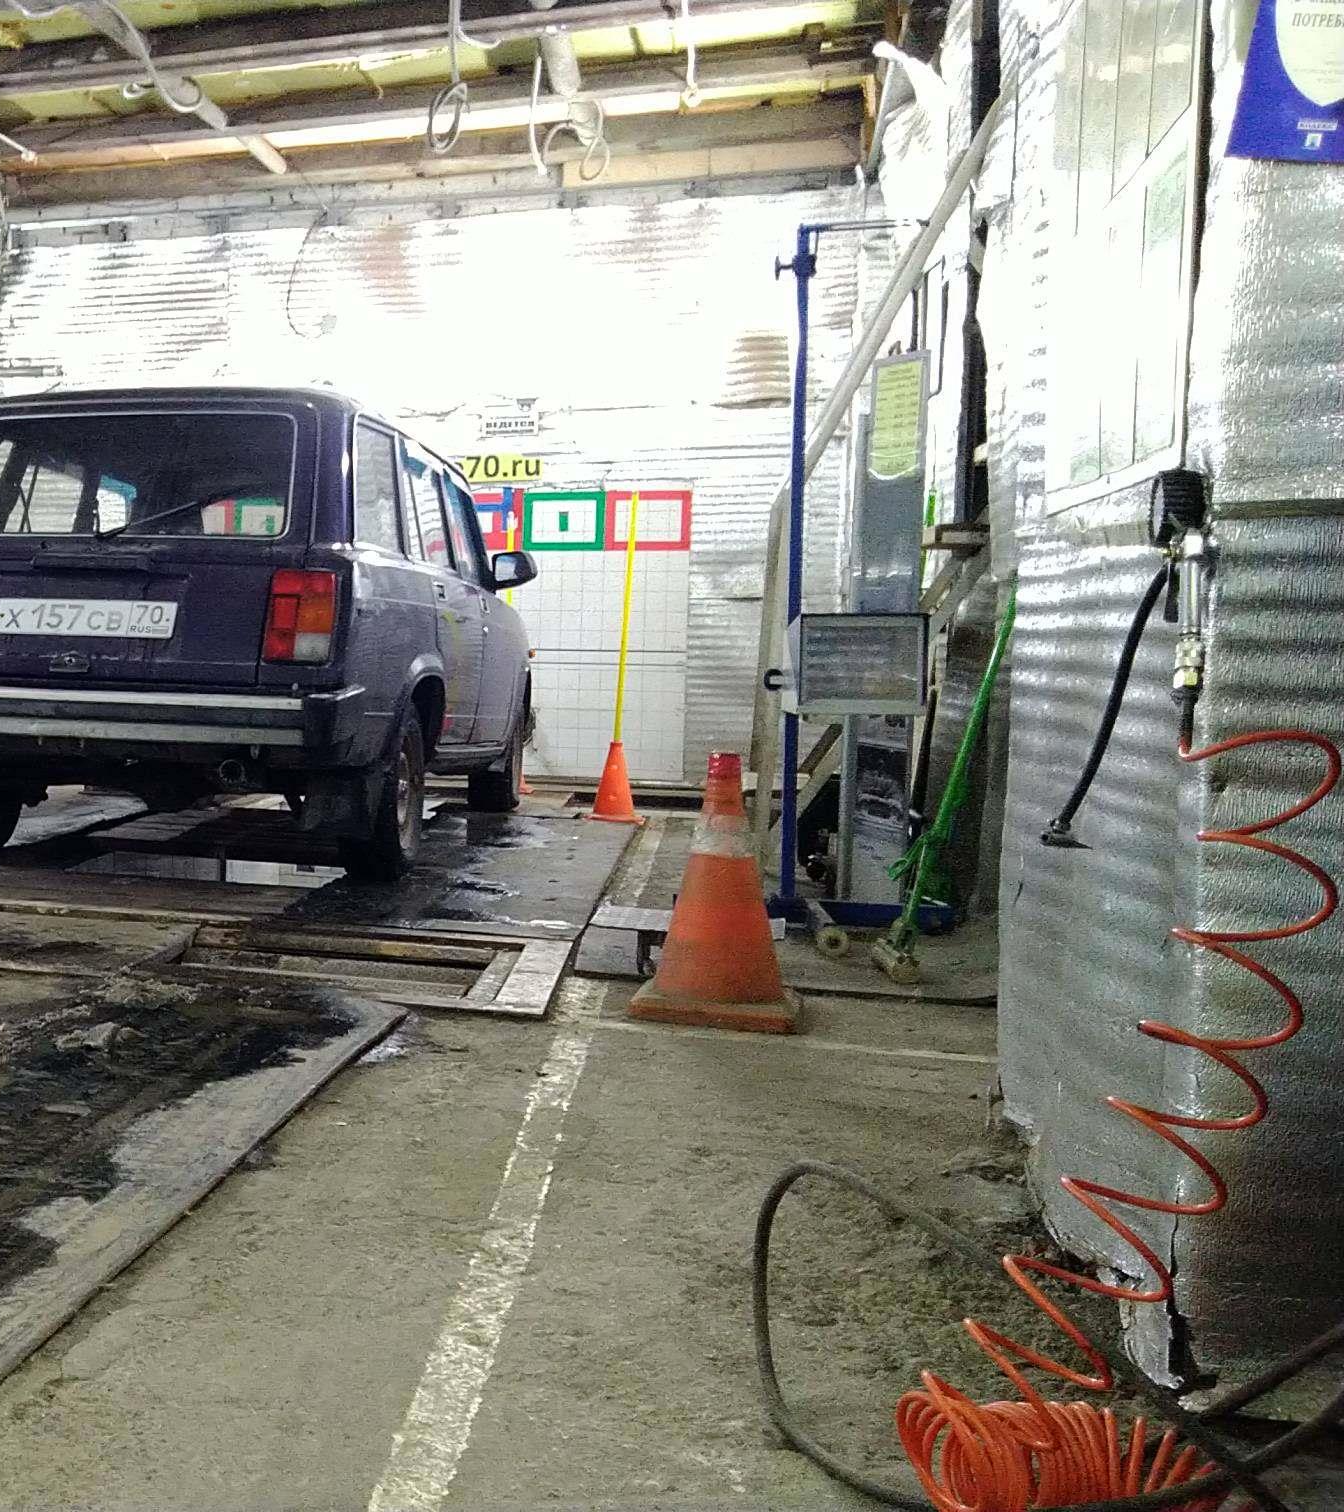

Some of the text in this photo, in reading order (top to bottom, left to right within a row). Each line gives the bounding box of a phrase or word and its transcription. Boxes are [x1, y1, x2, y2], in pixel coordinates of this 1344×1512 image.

[455, 455, 540, 478] 70.ru
[136, 604, 164, 625] 70
[129, 625, 152, 634] RUS
